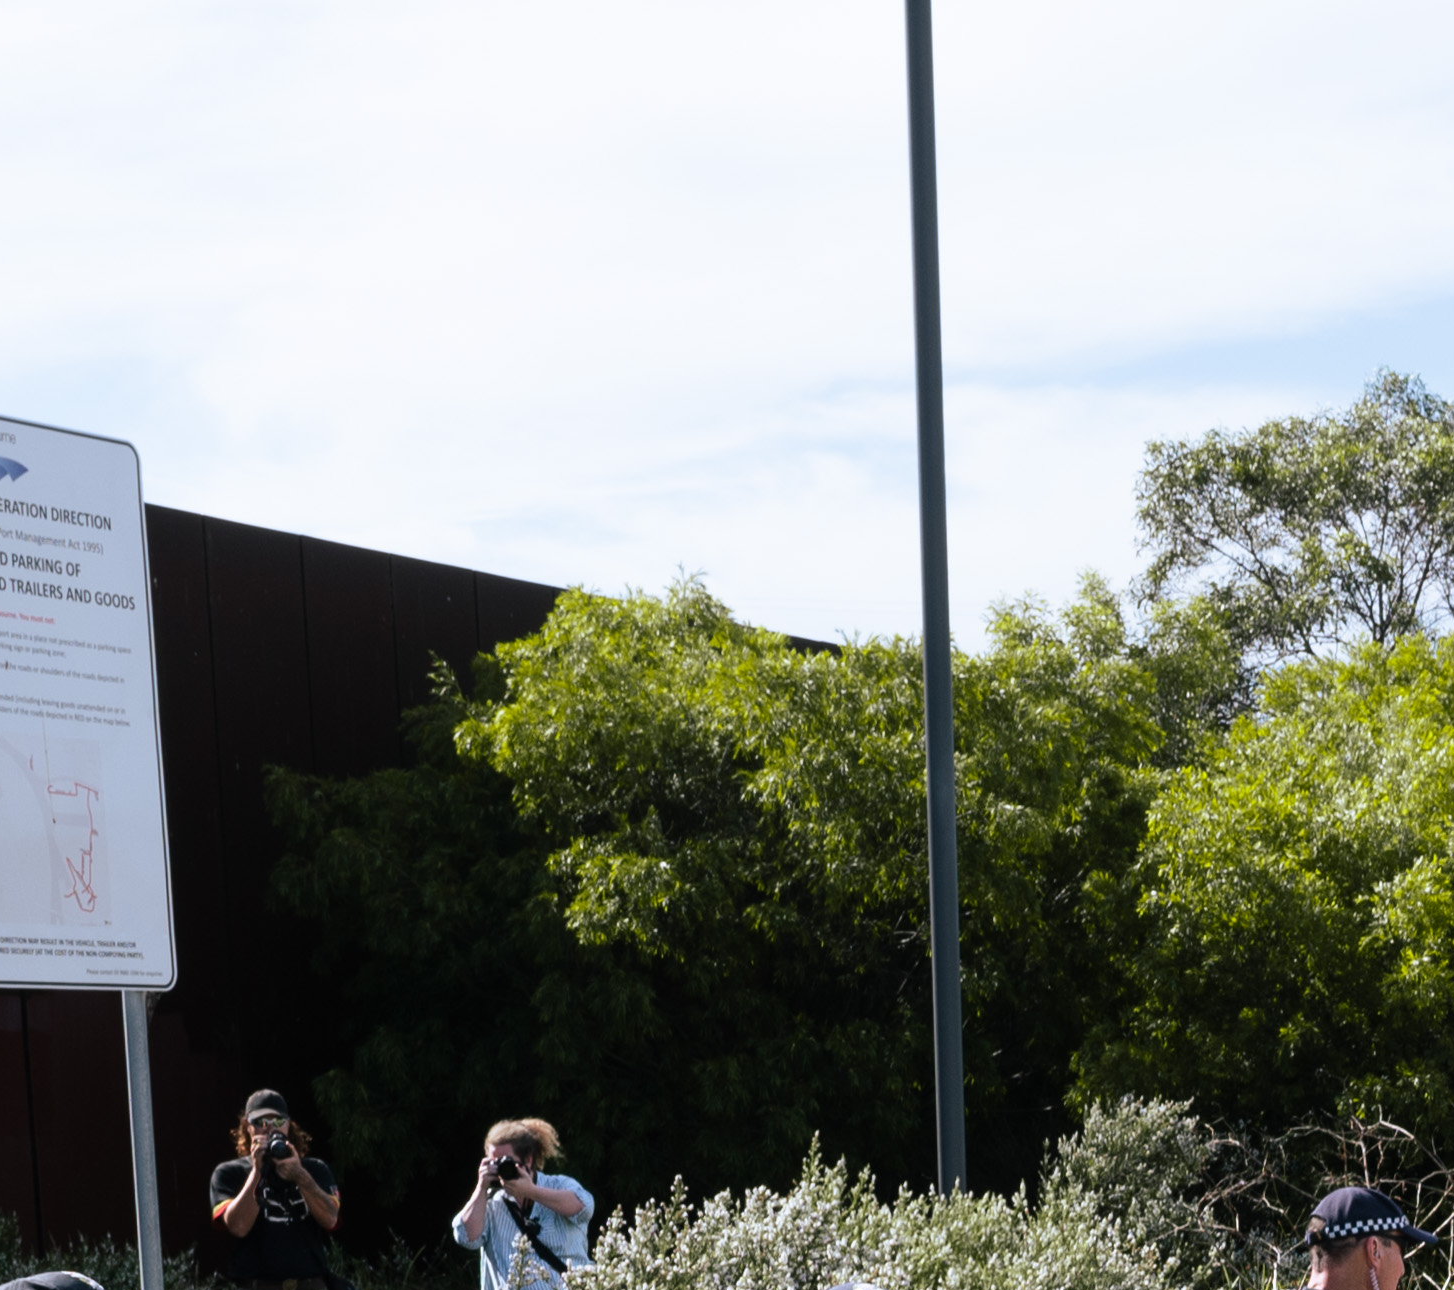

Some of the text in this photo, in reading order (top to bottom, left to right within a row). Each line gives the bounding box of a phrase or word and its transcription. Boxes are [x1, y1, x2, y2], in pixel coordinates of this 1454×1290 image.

[50, 506, 112, 531] DIRECTION
[15, 529, 66, 549] Management
[68, 536, 81, 551] Act
[82, 538, 104, 556] 1995)
[11, 554, 63, 576] PARKING
[65, 562, 81, 578] OF
[9, 578, 63, 600] TRAILERS
[65, 587, 92, 605] AND
[94, 592, 136, 611] GOODS
